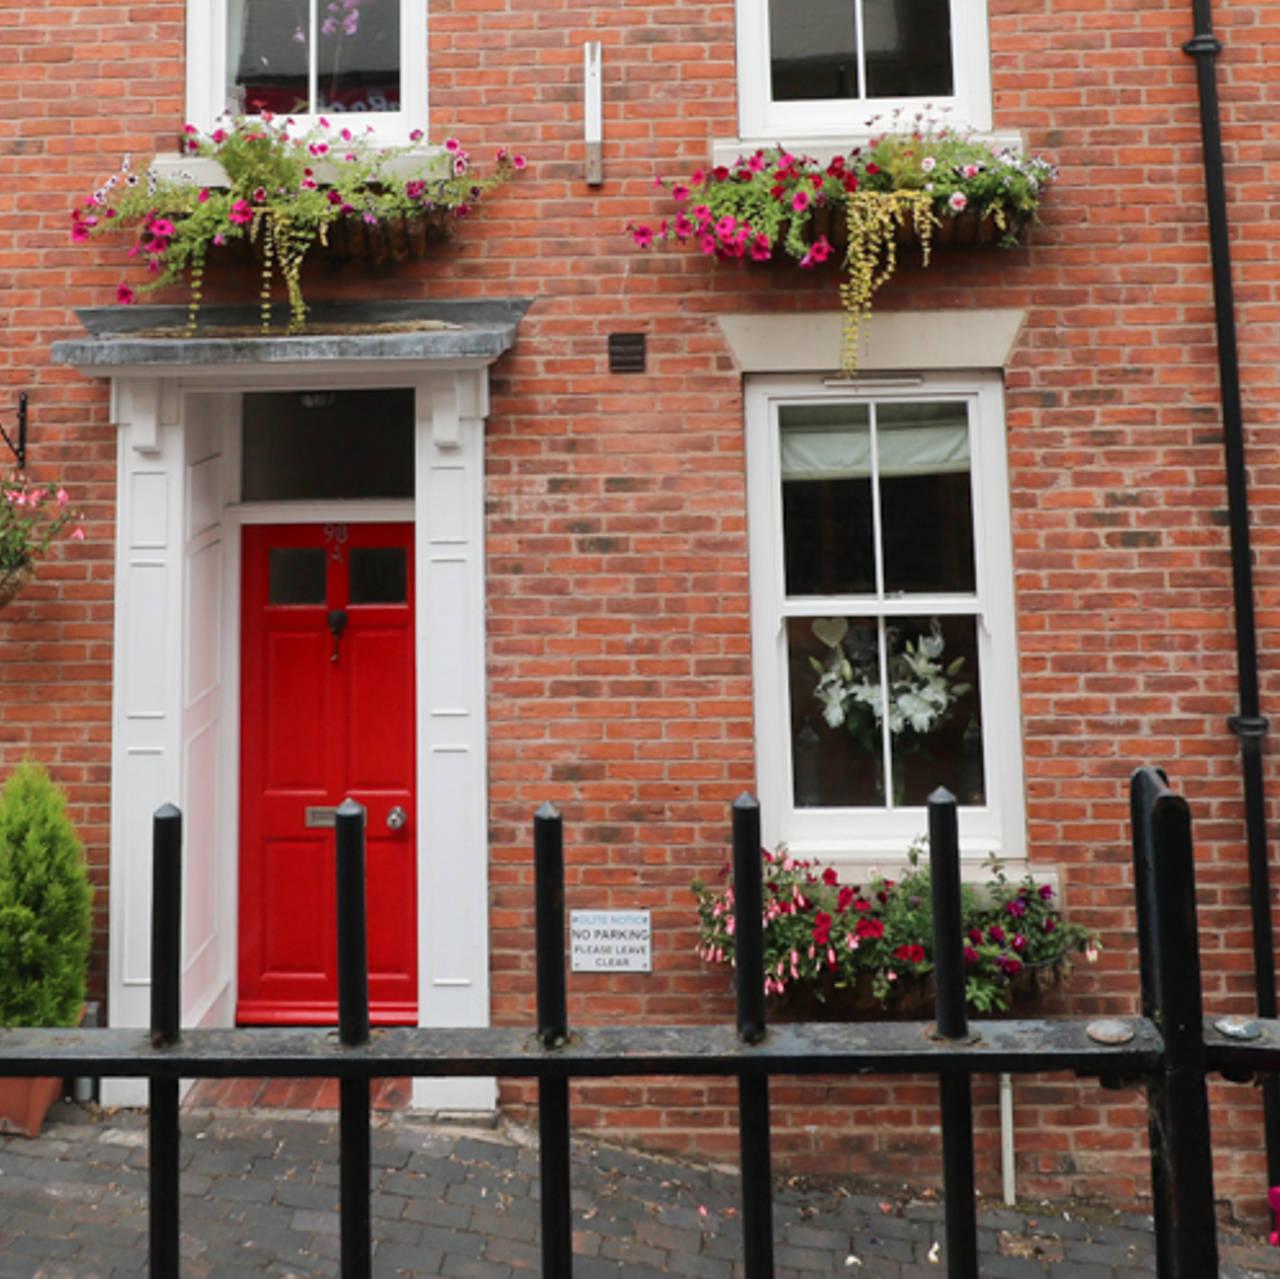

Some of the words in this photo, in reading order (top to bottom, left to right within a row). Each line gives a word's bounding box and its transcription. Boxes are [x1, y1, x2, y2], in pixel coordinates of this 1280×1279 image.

[572, 928, 591, 940] NO
[593, 928, 650, 941] PARKING
[574, 945, 612, 955] PLEASE
[615, 945, 646, 955] LEAVE
[595, 958, 629, 968] CLEAR
